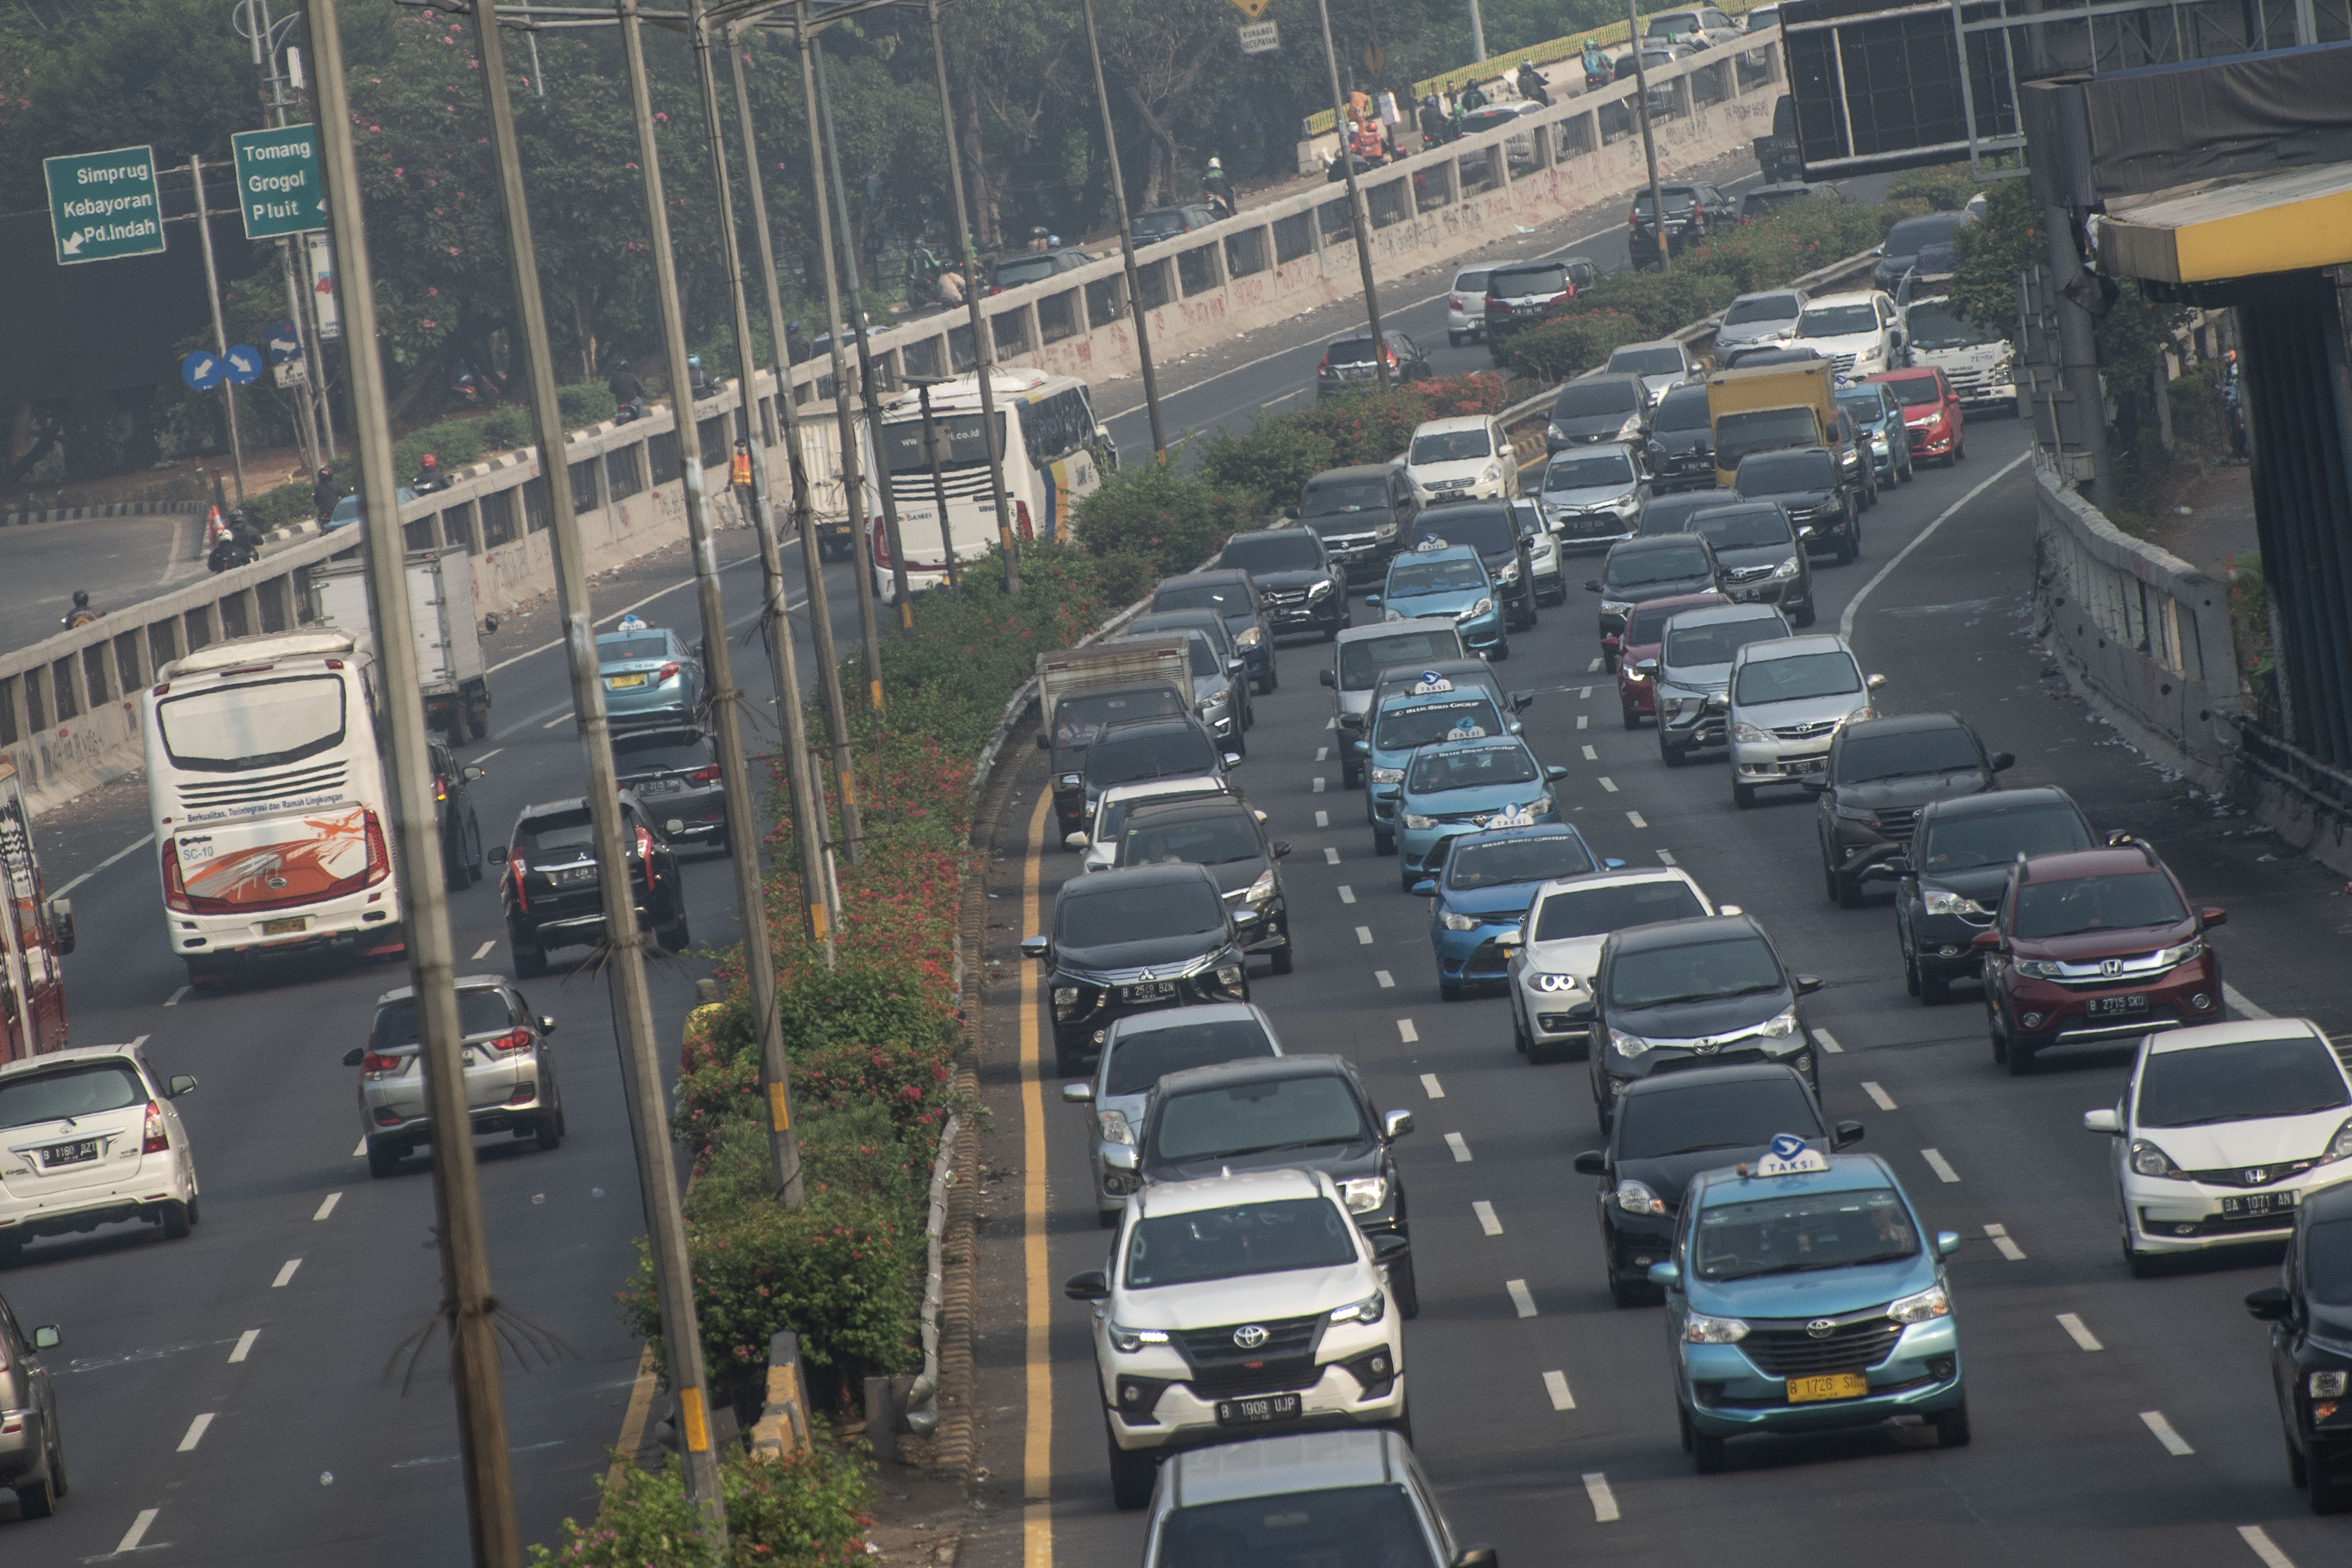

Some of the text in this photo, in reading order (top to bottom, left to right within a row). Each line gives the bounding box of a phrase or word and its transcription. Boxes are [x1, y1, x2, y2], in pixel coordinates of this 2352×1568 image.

[243, 142, 310, 162] Tomang
[76, 164, 148, 184] Simprug
[249, 169, 305, 192] Grogol
[64, 193, 152, 218] Kebayoran
[253, 200, 299, 220] Pluit
[84, 219, 155, 243] Pd.Indah
[187, 794, 343, 823] Berkualitas, Terintegrasi dan Ramah Lingkungan
[1497, 818, 1526, 827] TAKSI
[183, 845, 213, 860] SC-10
[1122, 988, 1128, 998] B
[2090, 1000, 2096, 1011] B
[44, 1150, 50, 1160] B
[56, 1145, 74, 1157] 1160
[1768, 1160, 1813, 1172] TAKSI
[2225, 1192, 2291, 1212] BA 1071 AN
[1790, 1381, 1798, 1395] B
[1806, 1377, 1833, 1393] 1726
[1221, 1396, 1295, 1419] B 1909 UJP
